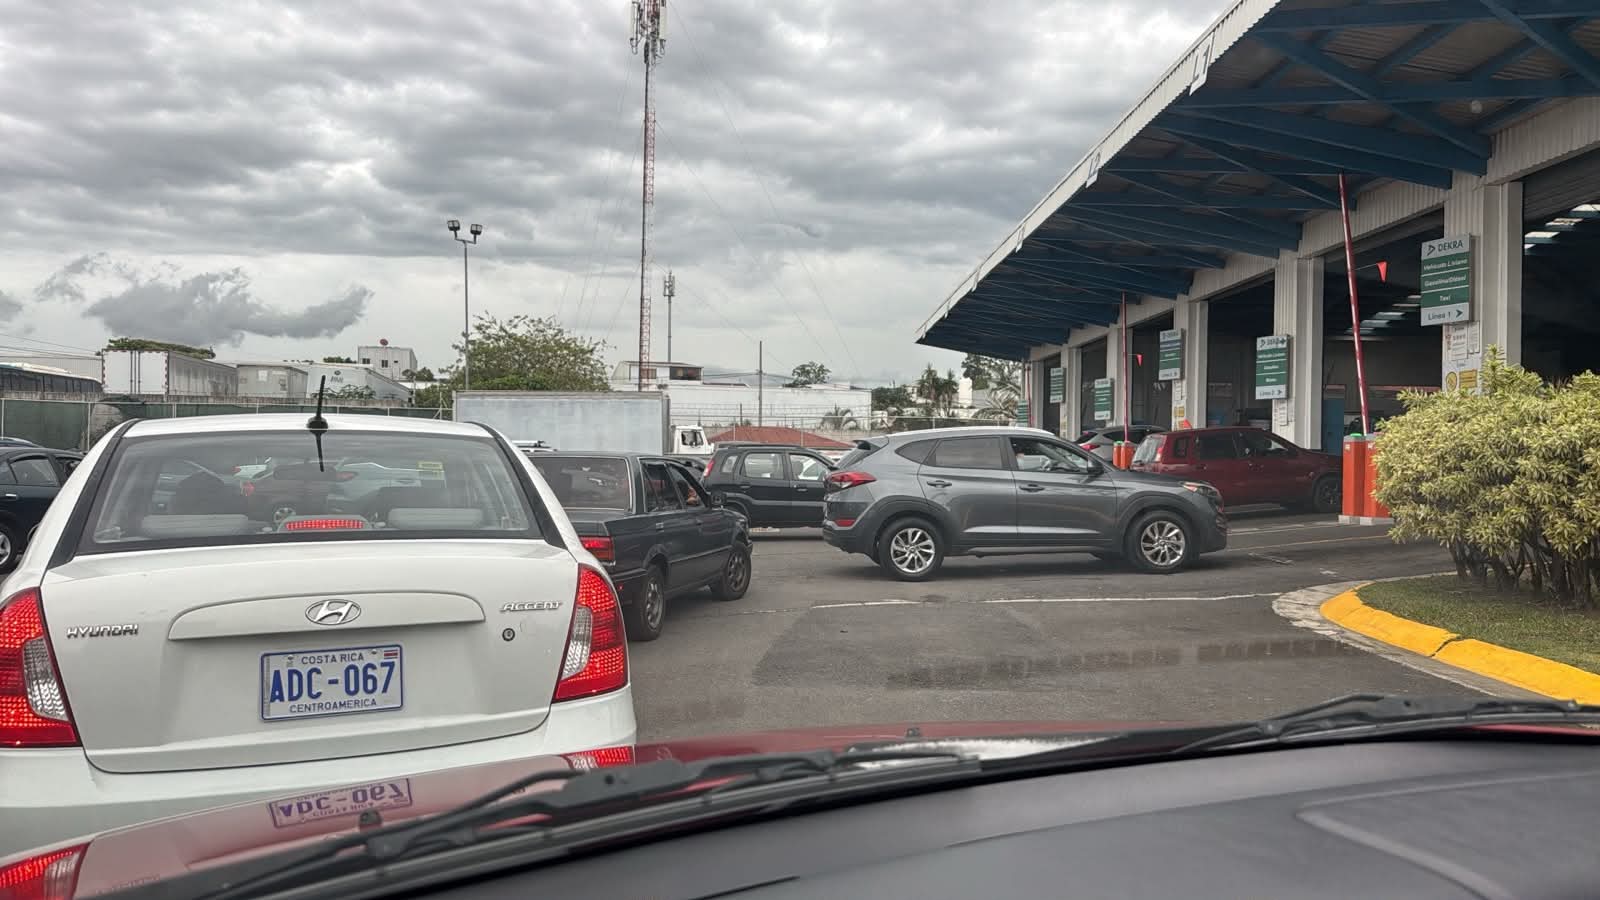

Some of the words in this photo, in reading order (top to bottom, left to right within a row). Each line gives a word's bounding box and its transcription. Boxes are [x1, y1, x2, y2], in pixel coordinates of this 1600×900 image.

[1438, 240, 1464, 252] DEKRA
[500, 600, 563, 613] ACCENT
[66, 623, 139, 639] HYUNDAI
[301, 655, 337, 665] COSTA
[340, 652, 365, 663] RICA
[269, 661, 396, 703] ADC-067
[289, 698, 377, 714] CENTROAMERICA
